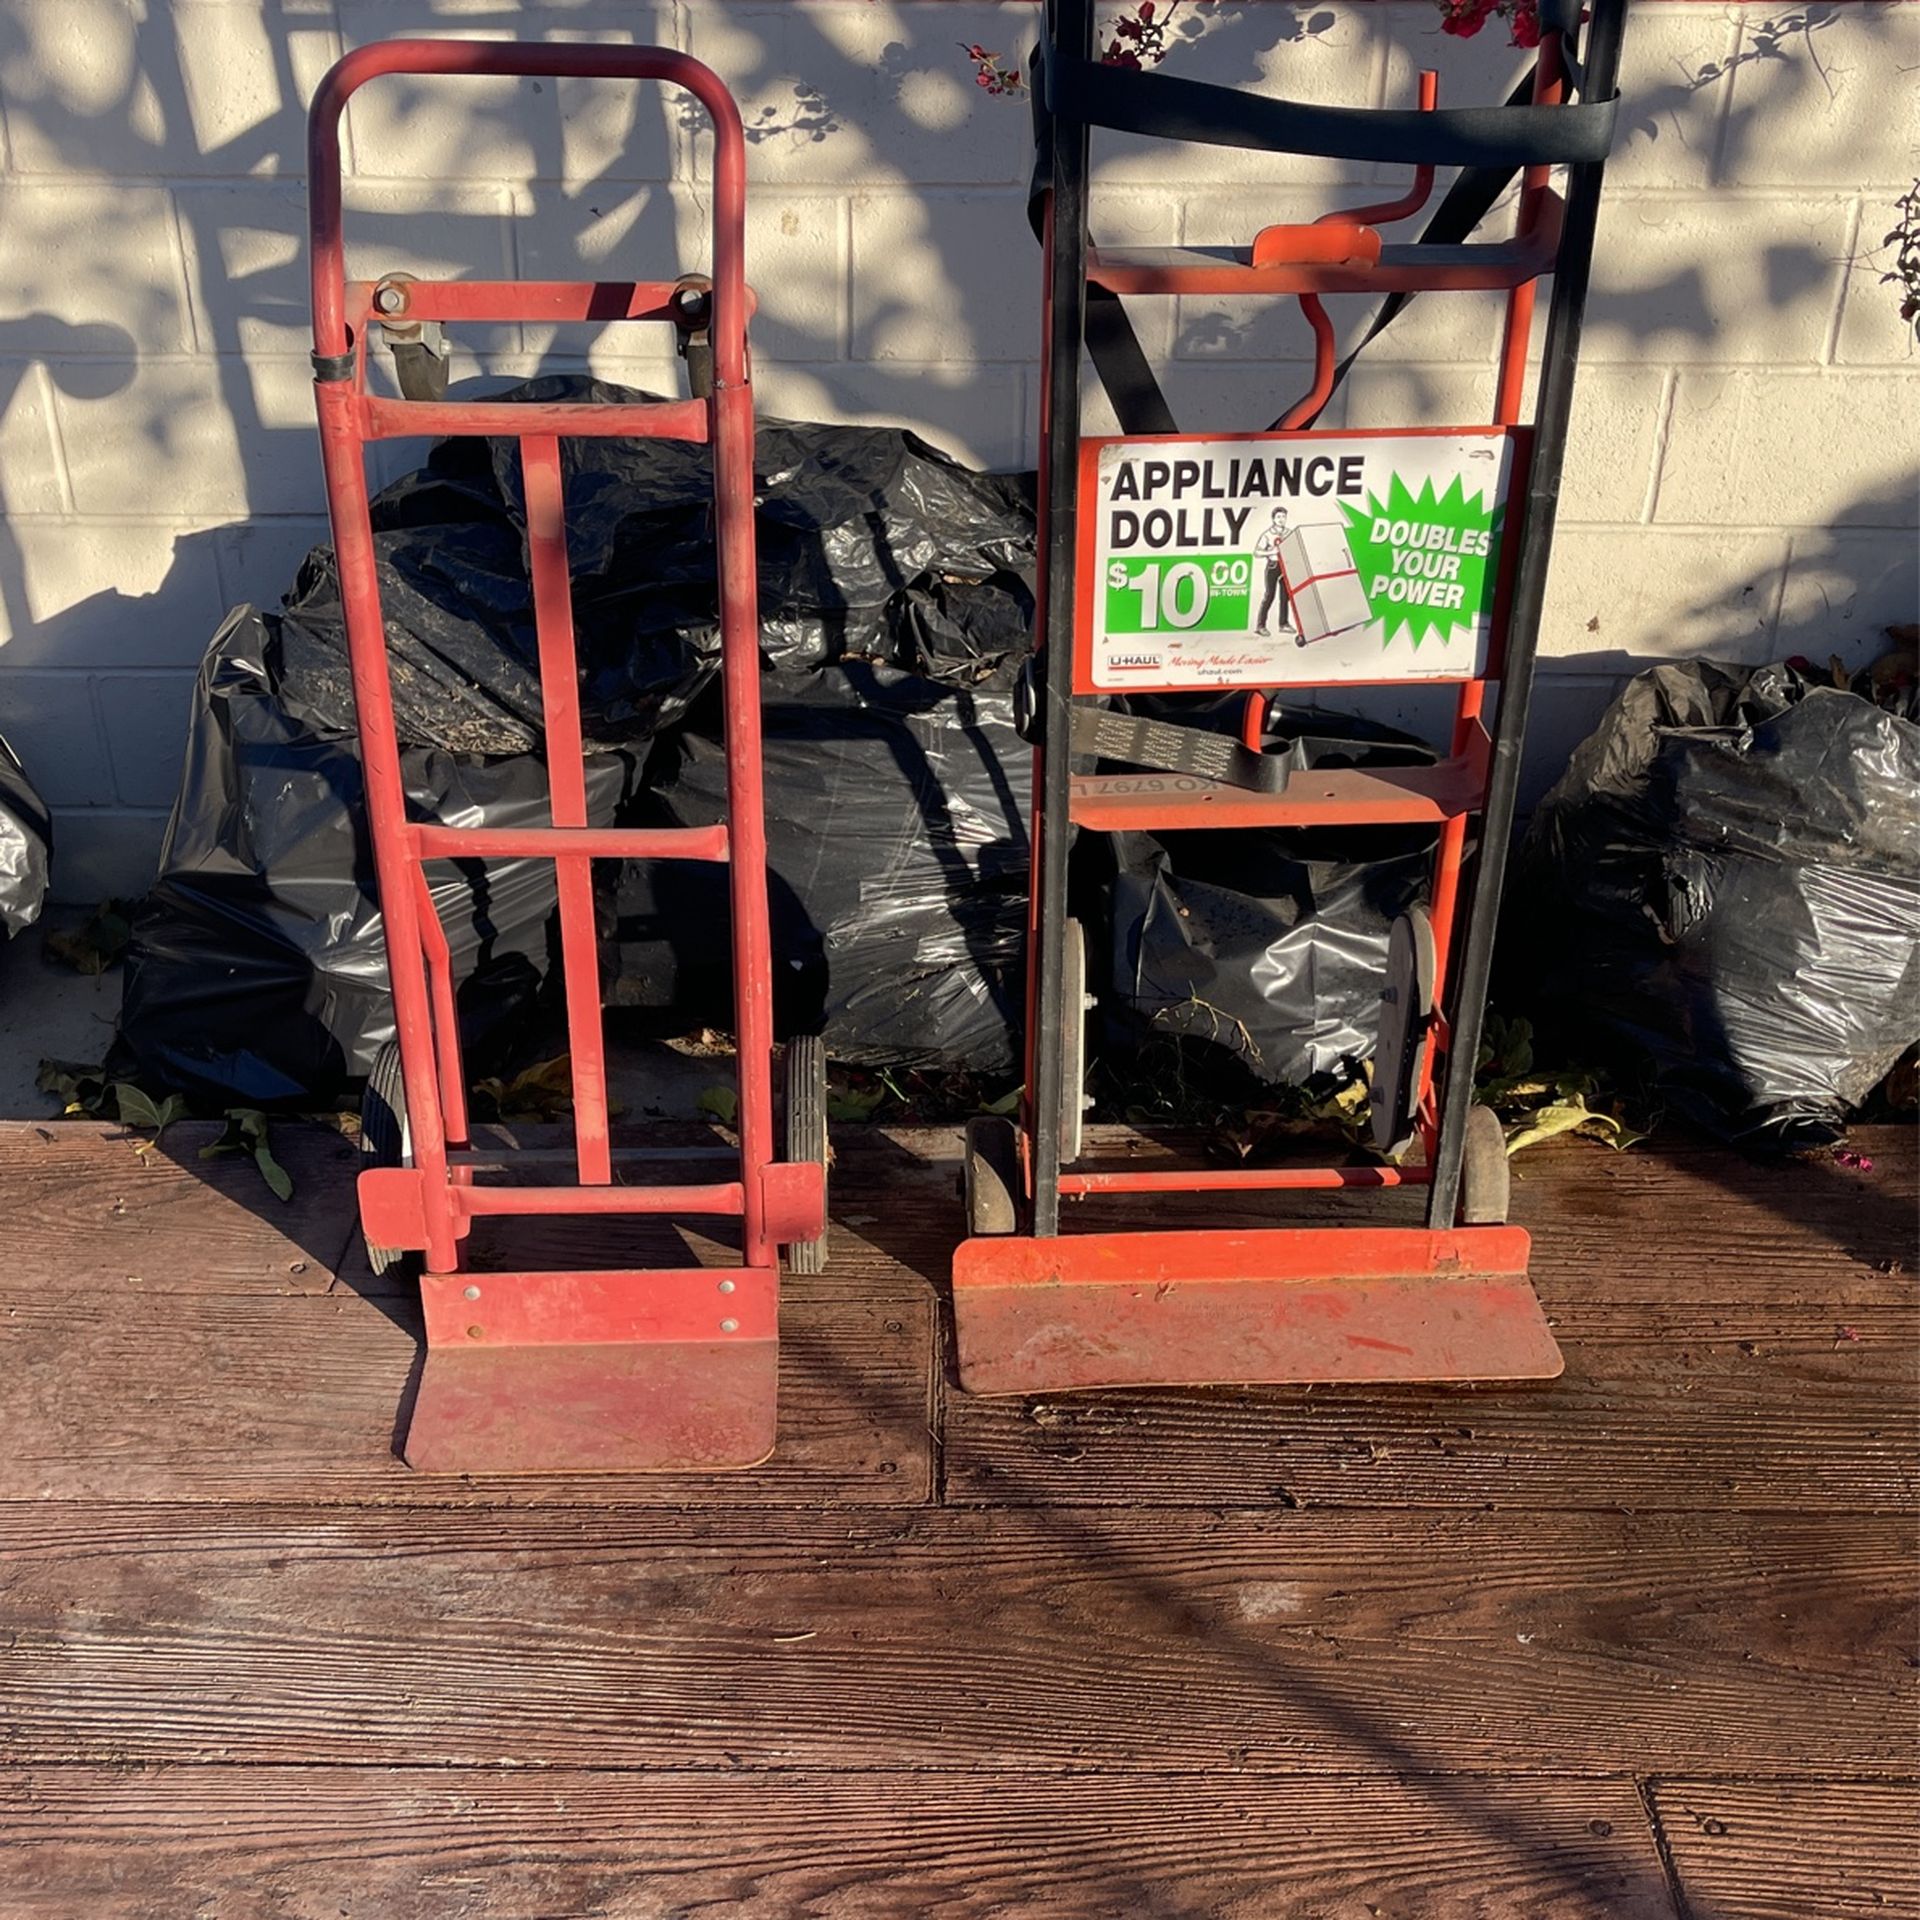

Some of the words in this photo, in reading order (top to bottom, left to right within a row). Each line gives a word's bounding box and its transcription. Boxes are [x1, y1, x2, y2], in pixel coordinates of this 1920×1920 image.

[1110, 456, 1365, 500] APPLIANCE
[1111, 507, 1252, 549] DOLLY
[1370, 517, 1494, 557] DOUBLES
[1391, 548, 1461, 581] YOUR
[1369, 574, 1465, 610] POWER
[1109, 655, 1160, 666] U-HAUL
[1168, 656, 1206, 669] Moving
[1206, 655, 1235, 666] Made
[1197, 667, 1243, 676] uhaul.com
[1097, 779, 1165, 794] 6797
